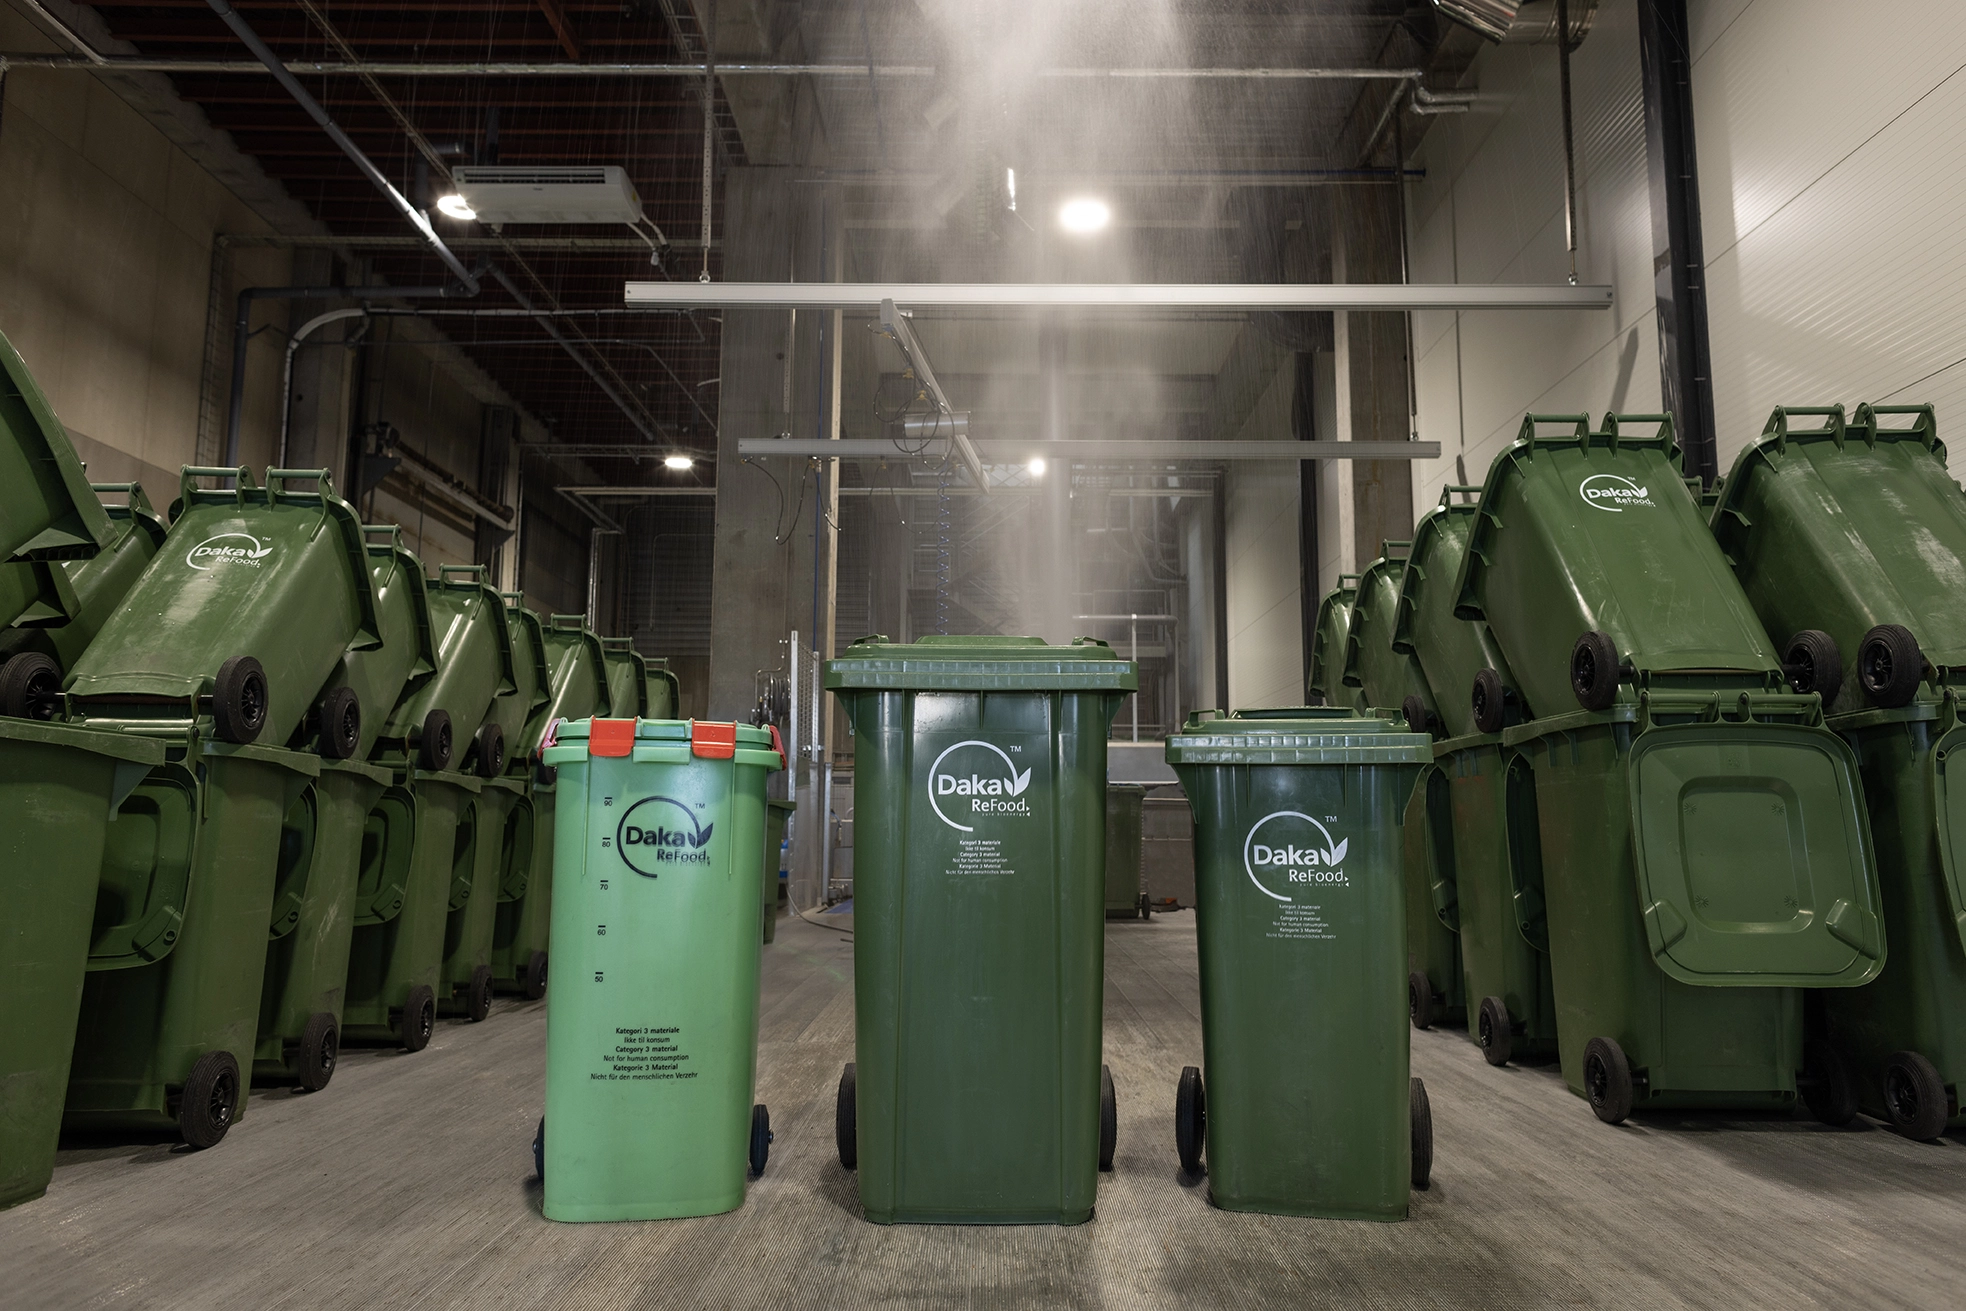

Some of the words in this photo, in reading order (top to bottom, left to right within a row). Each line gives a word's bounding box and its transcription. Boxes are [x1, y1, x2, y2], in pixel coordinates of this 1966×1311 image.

[1586, 487, 1633, 499] Daka
[1614, 497, 1651, 505] ReFood
[194, 546, 246, 557] Daka
[215, 555, 260, 566] ReFood
[938, 774, 1002, 795] Daka
[971, 797, 1026, 812] ReFood
[626, 826, 686, 847] Daka
[657, 848, 707, 862] ReFood
[1253, 844, 1320, 866] Daka
[1288, 867, 1344, 882] ReFood
[616, 1027, 642, 1036] Kategori
[615, 1046, 643, 1054] Category
[649, 1054, 689, 1062] consumption
[613, 1064, 643, 1073] Kategorie
[652, 1063, 678, 1071] Material
